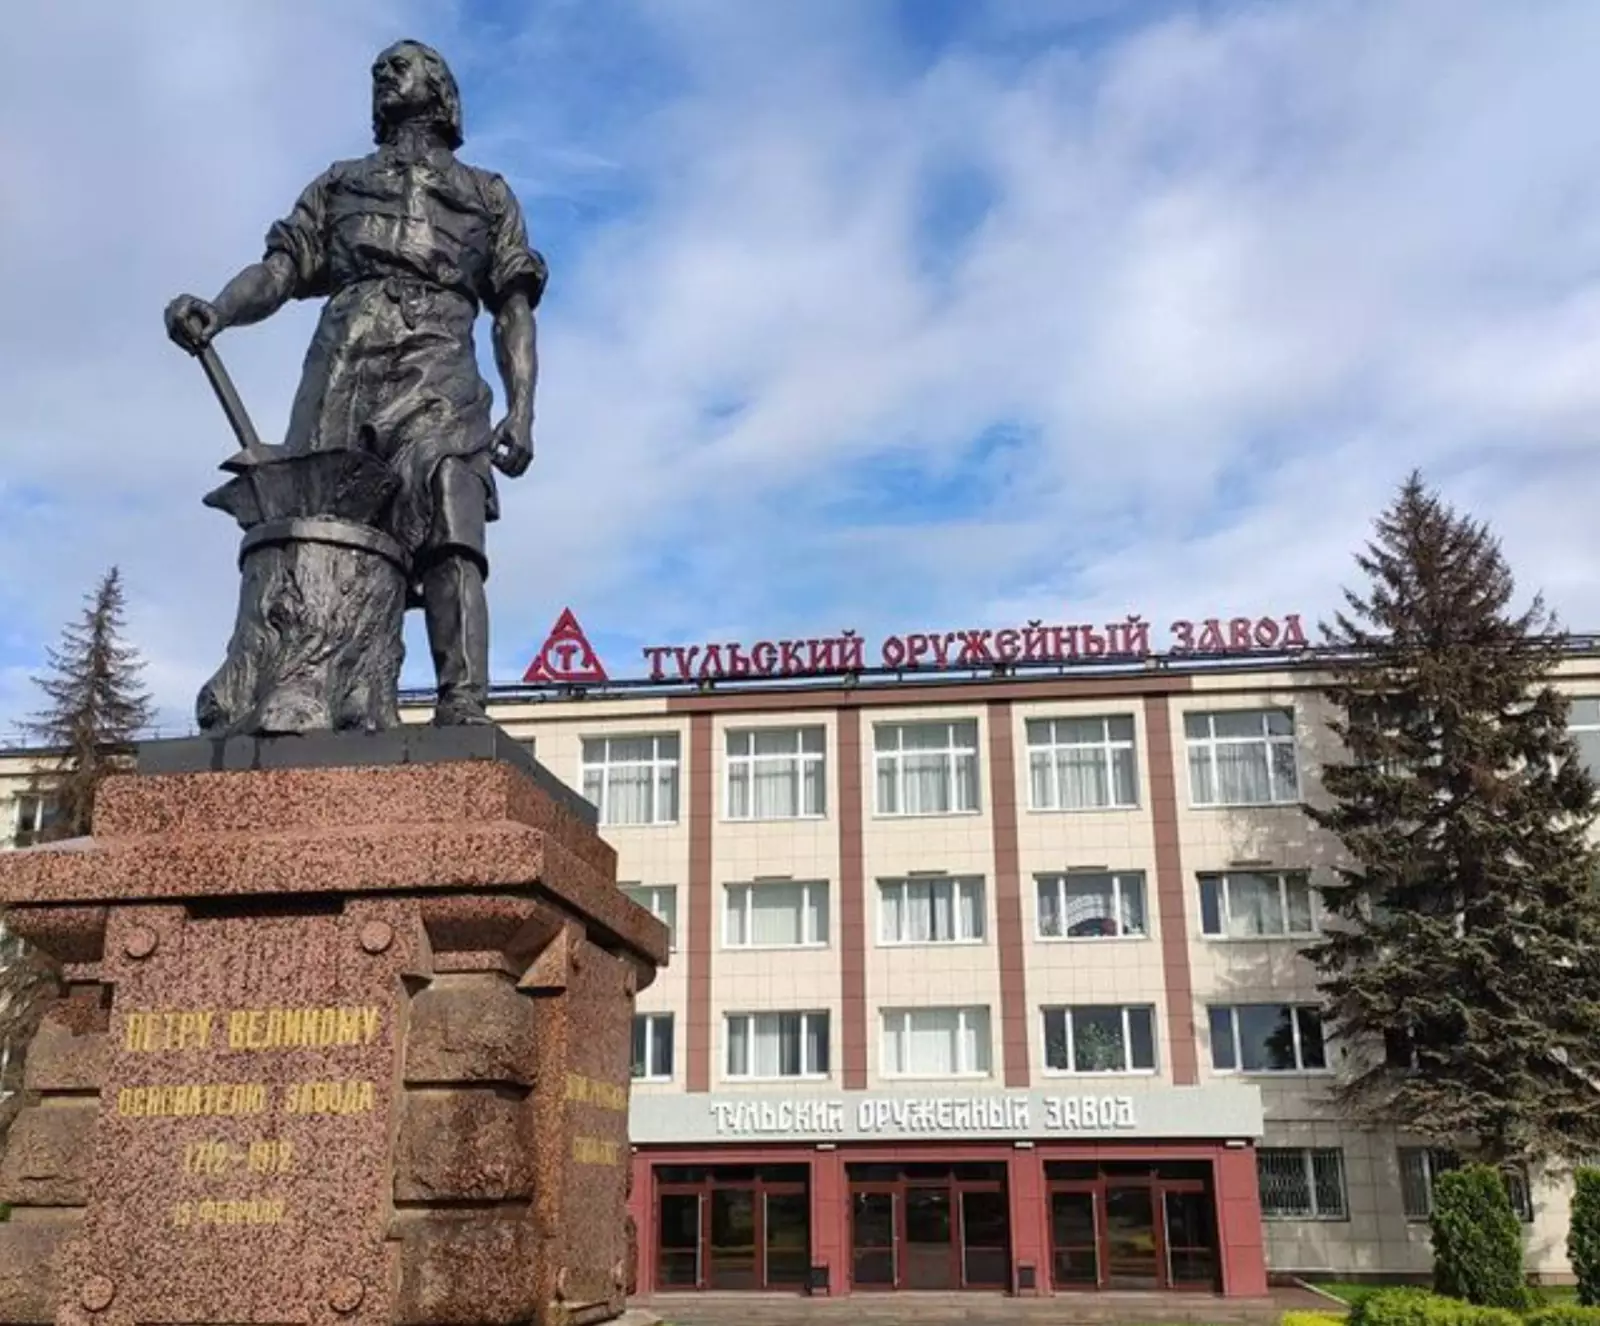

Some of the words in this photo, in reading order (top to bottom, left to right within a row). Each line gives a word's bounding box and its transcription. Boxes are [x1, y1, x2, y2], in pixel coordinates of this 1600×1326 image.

[643, 629, 865, 681] ТУЛЬСКИЙ
[881, 615, 1151, 669] ОРУЖЕЙНЫЙ
[1170, 613, 1309, 653] ЗАВОД
[125, 1011, 215, 1050] ПЕТРУ
[228, 1005, 379, 1049] ВЕЛИКОМУ
[710, 1099, 844, 1133] ТУЛЬСКИЙ
[857, 1096, 1031, 1132] ОРУЖЕЙНЫЙ
[1043, 1095, 1137, 1130] ЗАВОД
